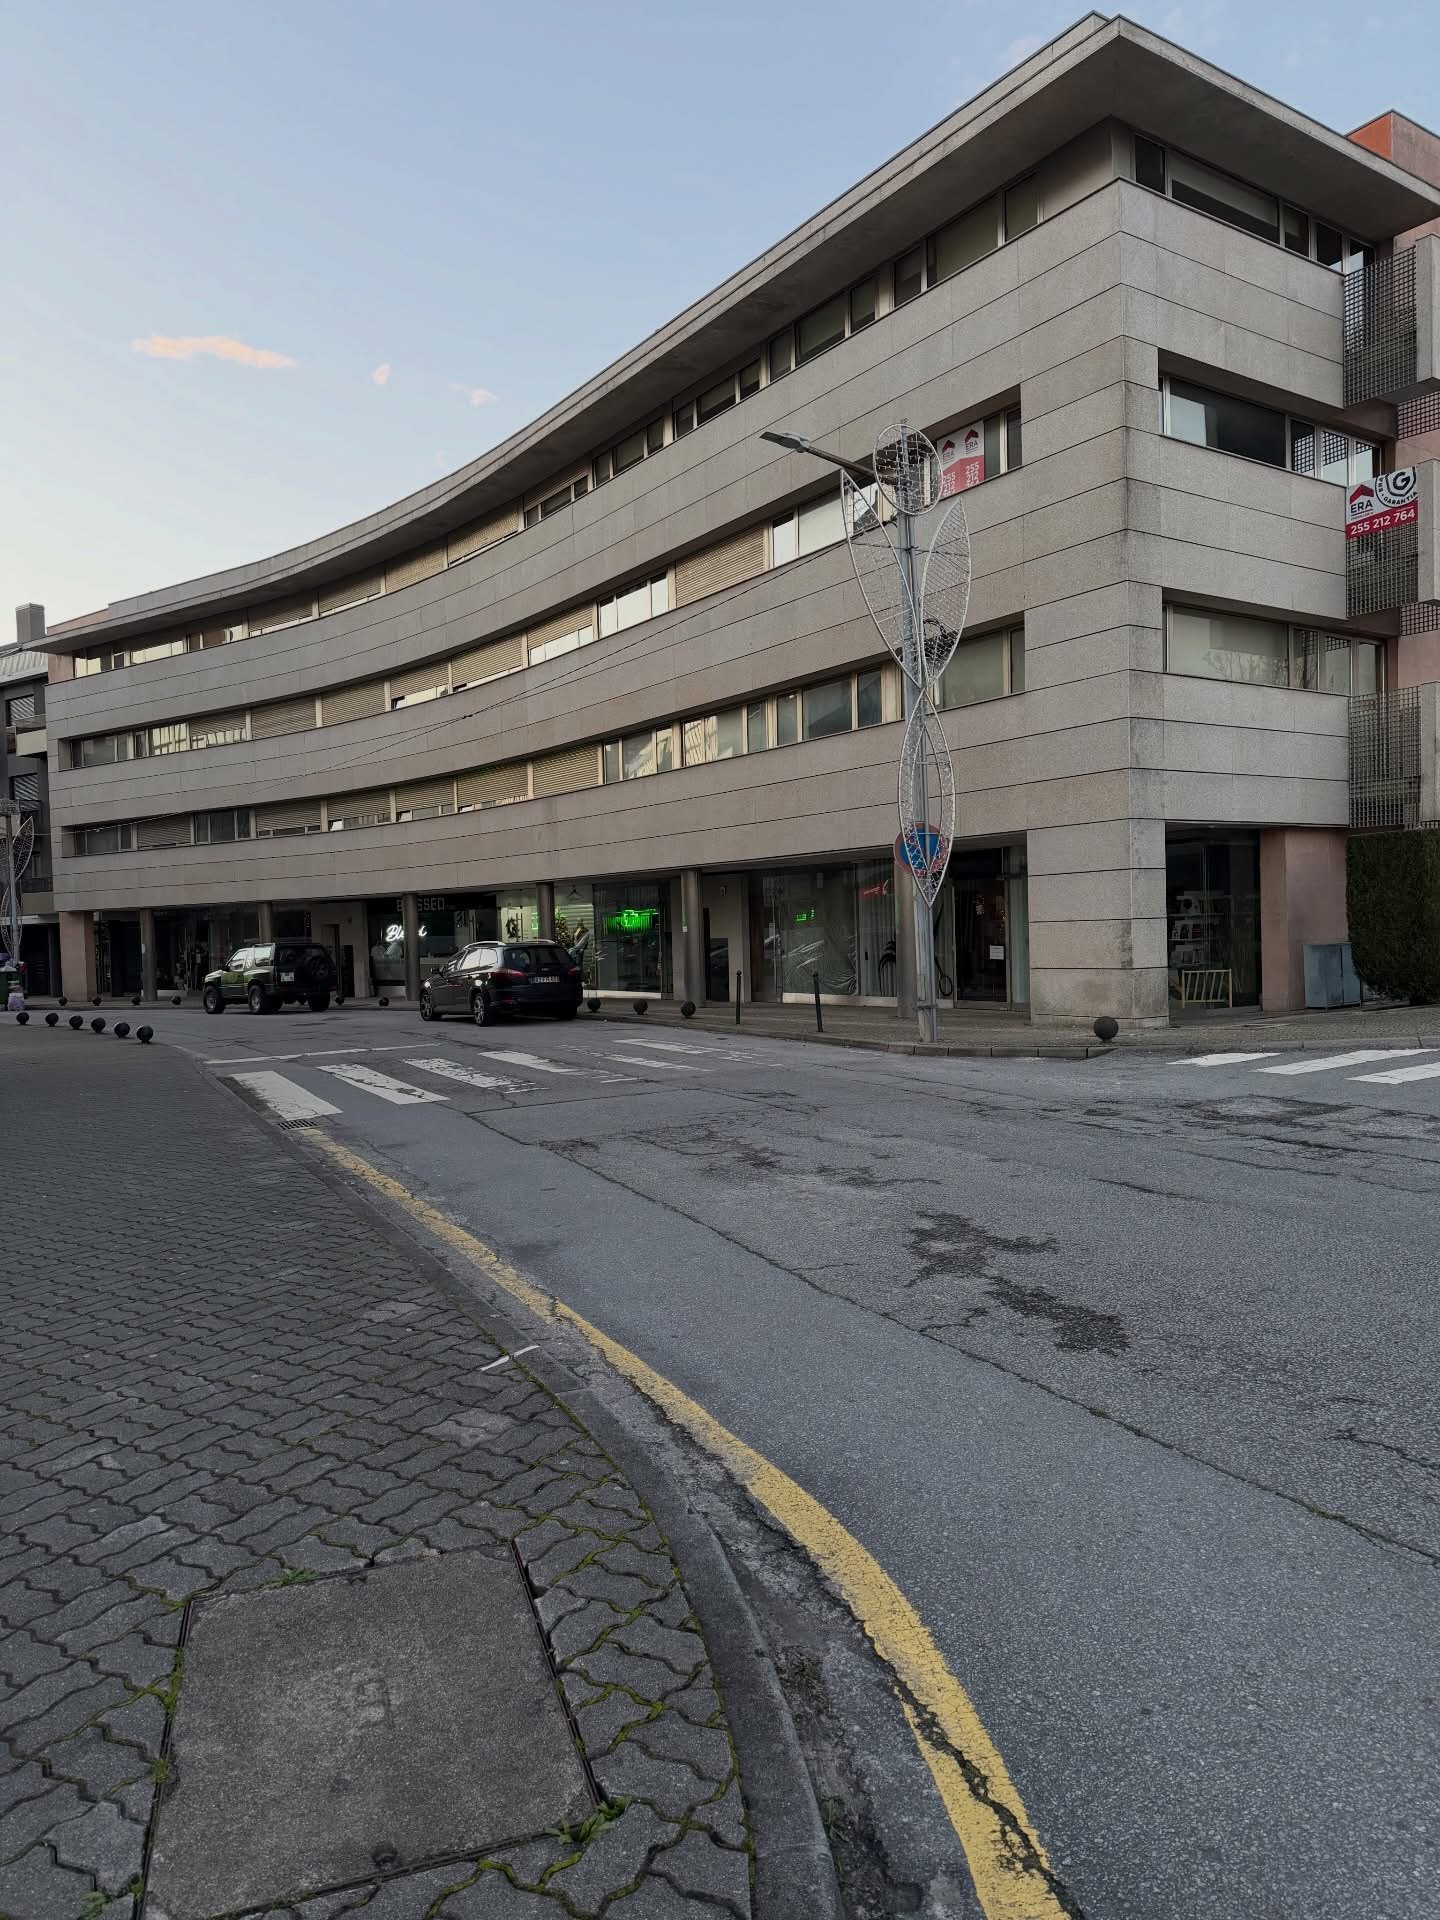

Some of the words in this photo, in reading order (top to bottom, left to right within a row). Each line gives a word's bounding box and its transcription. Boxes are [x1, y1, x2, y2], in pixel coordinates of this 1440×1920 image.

[966, 440, 977, 449] ERA
[966, 462, 979, 474] 255
[943, 472, 956, 482] 255
[967, 471, 979, 483] 212
[944, 481, 956, 492] 212
[1350, 500, 1373, 514] ERA
[1351, 521, 1370, 535] 255
[1373, 516, 1391, 529] 212
[1393, 509, 1415, 523] 764
